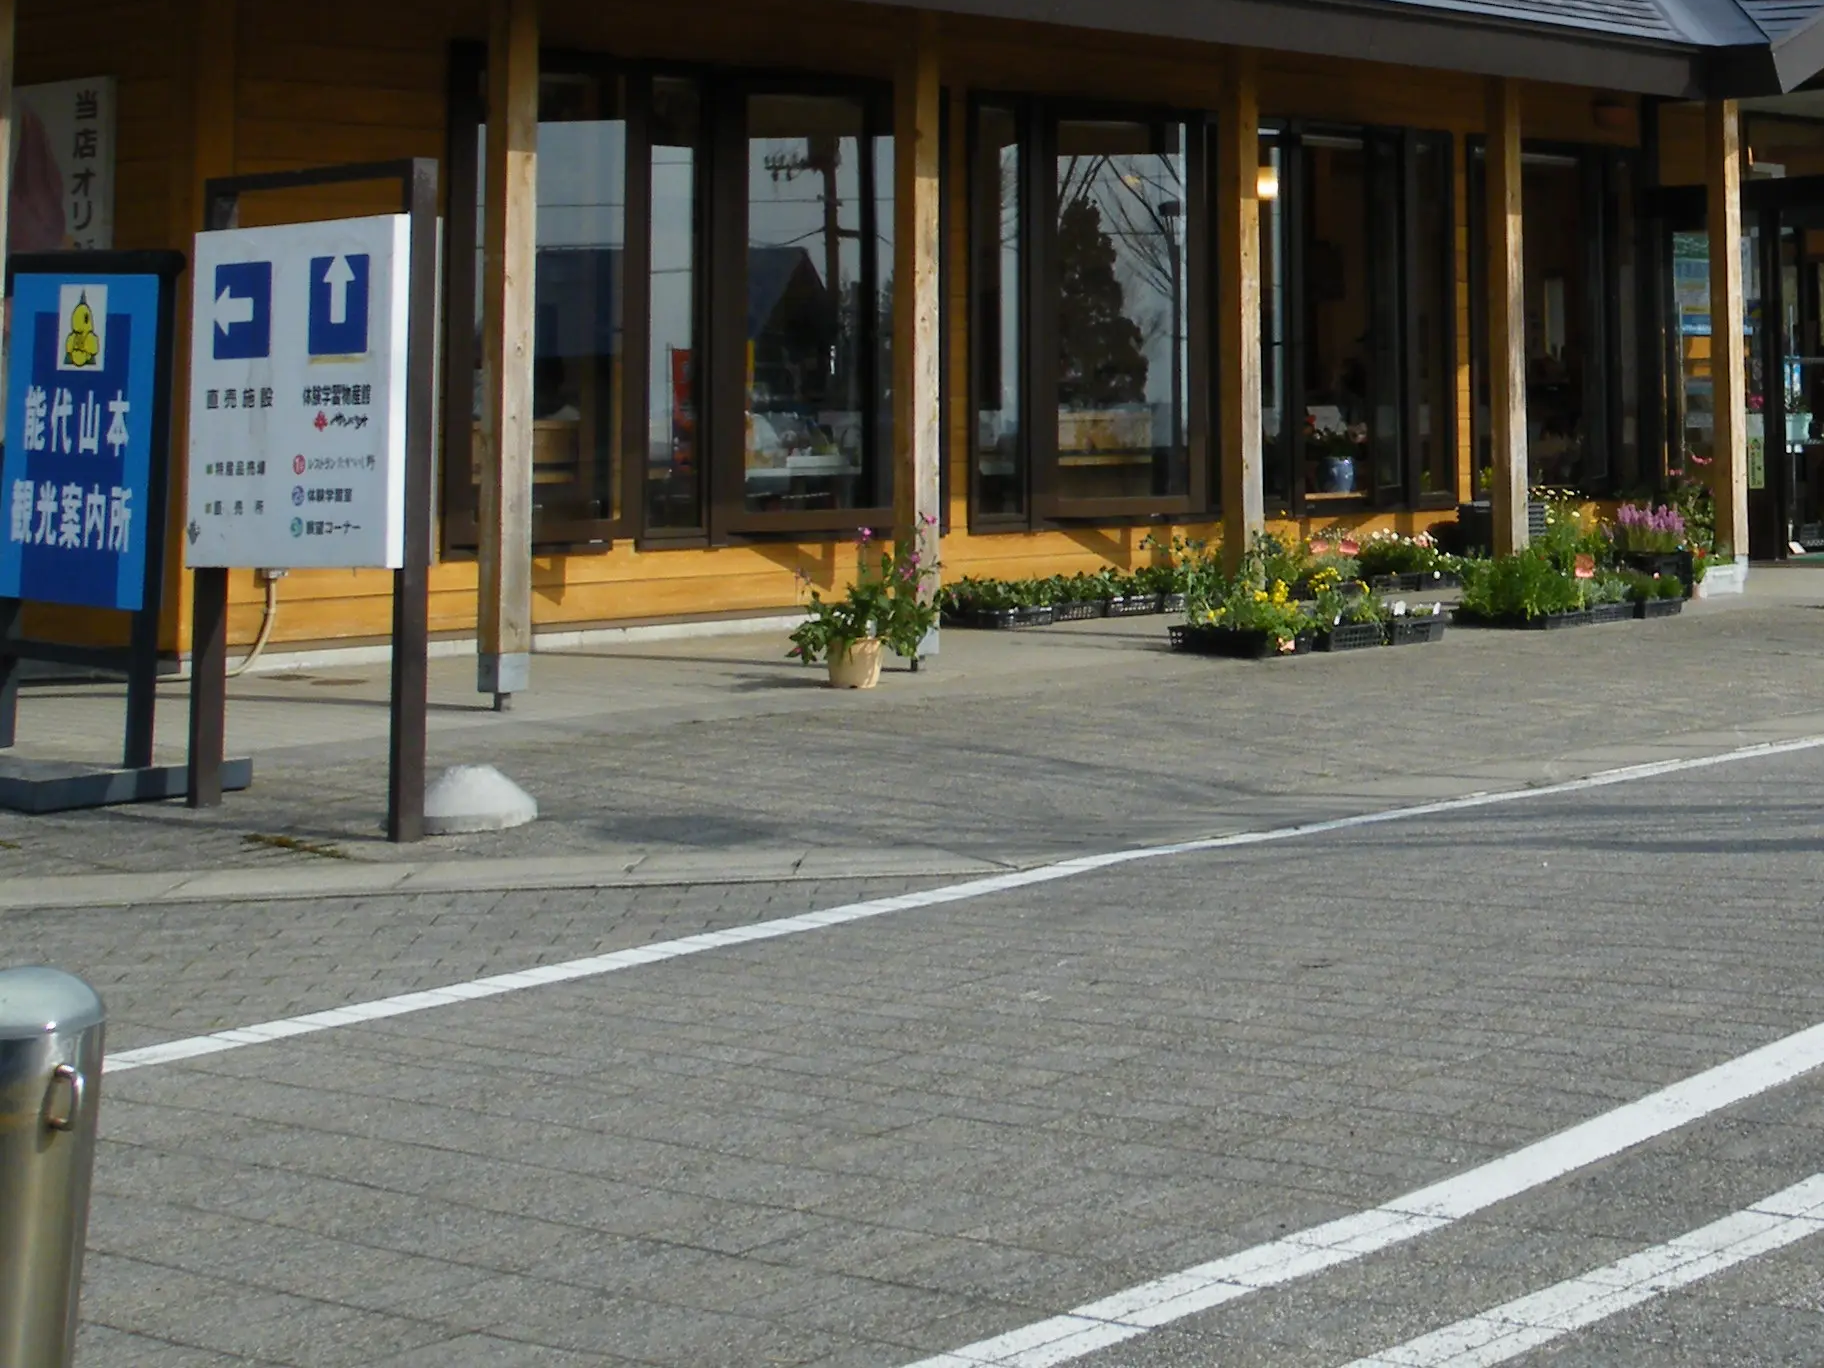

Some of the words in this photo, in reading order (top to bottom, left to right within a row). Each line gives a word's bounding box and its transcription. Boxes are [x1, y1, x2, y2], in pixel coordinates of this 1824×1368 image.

[23, 385, 131, 457] 能代山本
[10, 478, 133, 553] 観光案内所
